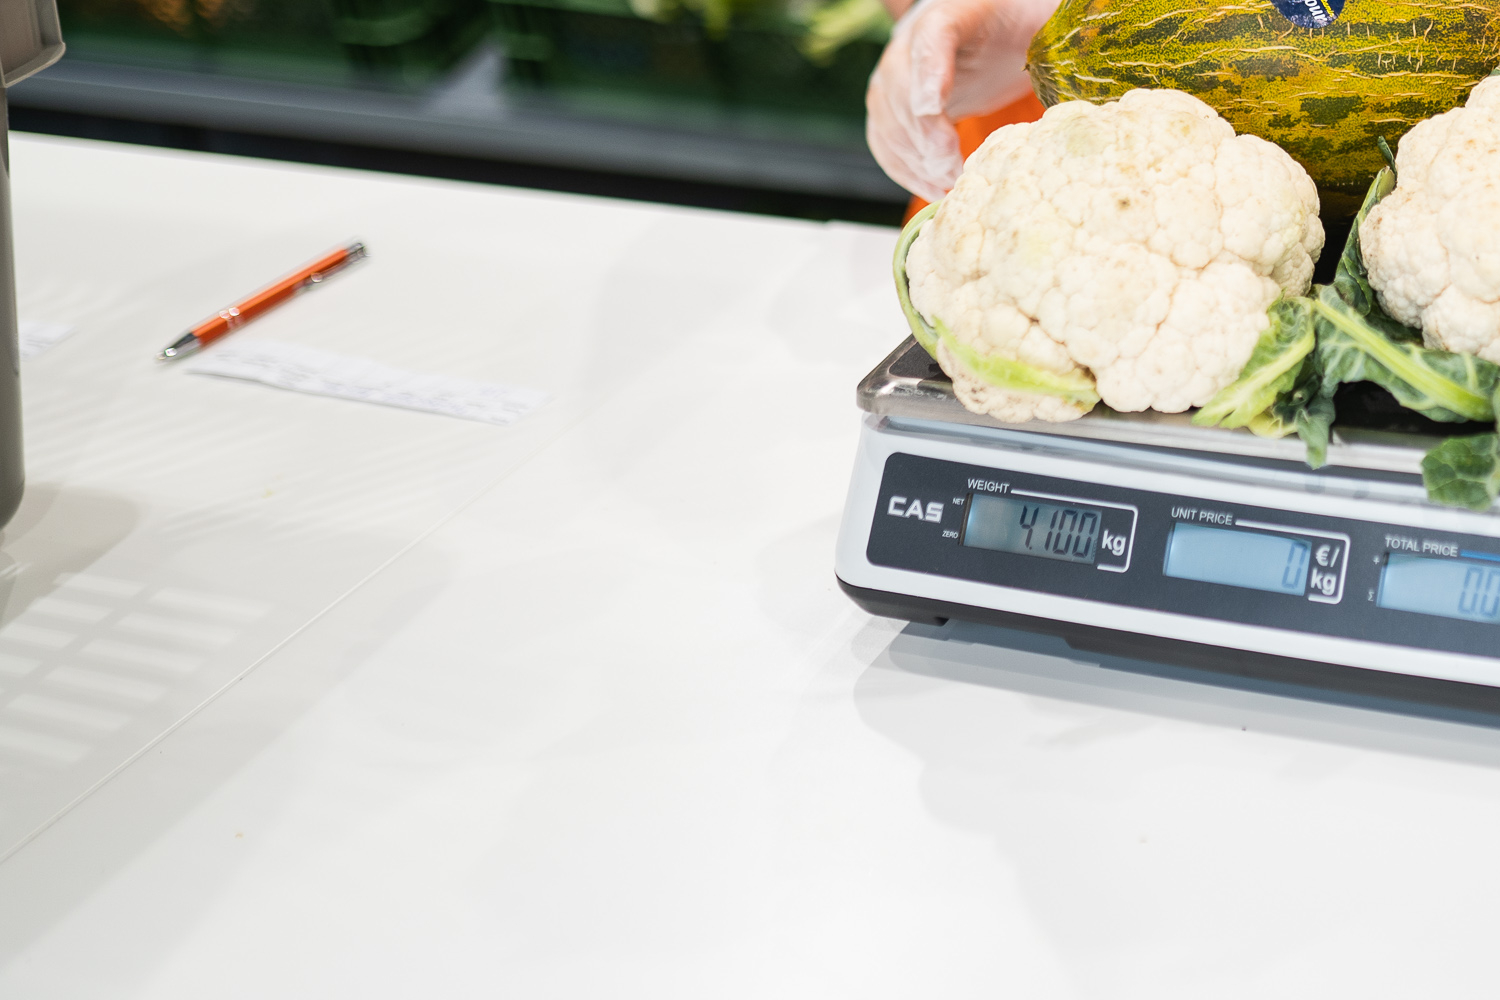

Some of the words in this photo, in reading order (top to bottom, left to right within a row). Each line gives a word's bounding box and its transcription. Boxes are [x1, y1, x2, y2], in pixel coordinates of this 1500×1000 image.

[967, 478, 1010, 494] WEIGHT
[888, 496, 944, 524] CAS
[952, 498, 965, 506] NET
[1171, 507, 1197, 521] UNIT
[1199, 510, 1233, 526] PRICE
[942, 530, 959, 539] ZERO
[1101, 529, 1126, 556] kg
[1385, 536, 1420, 552] TOTAL
[1422, 543, 1458, 558] PRICE
[1281, 542, 1308, 589] 0
[1310, 567, 1337, 596] kg
